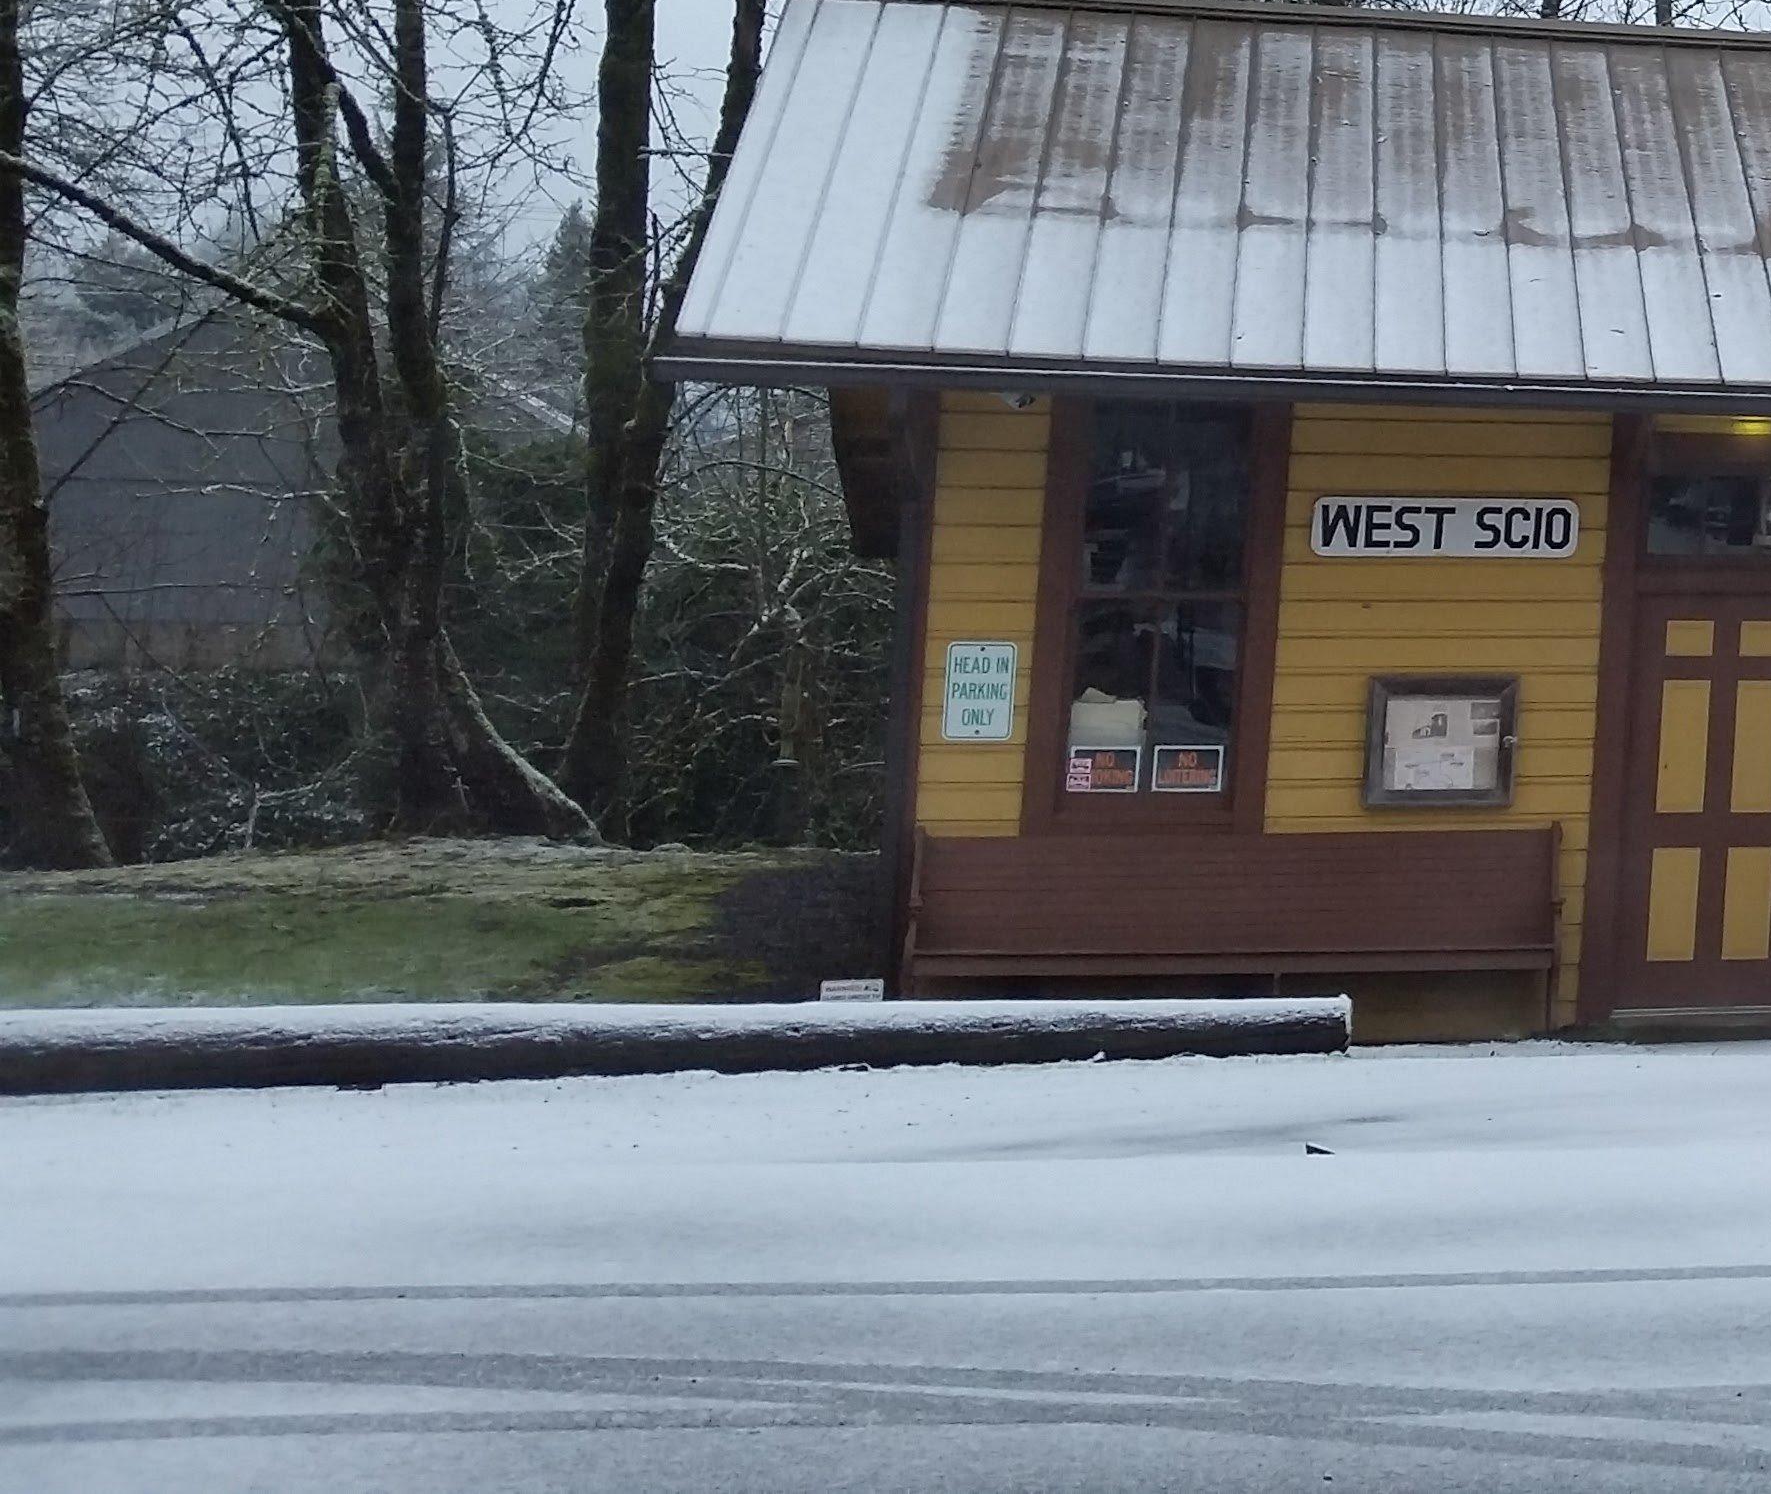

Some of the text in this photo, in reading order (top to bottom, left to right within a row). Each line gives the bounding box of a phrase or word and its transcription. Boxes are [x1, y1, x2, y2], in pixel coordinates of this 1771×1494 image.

[1320, 504, 1572, 550] WEST SCIO
[954, 655, 1010, 674] HEAD IN
[951, 682, 1008, 700] PARKING
[961, 708, 995, 726] ONLY
[1178, 751, 1198, 768] NO
